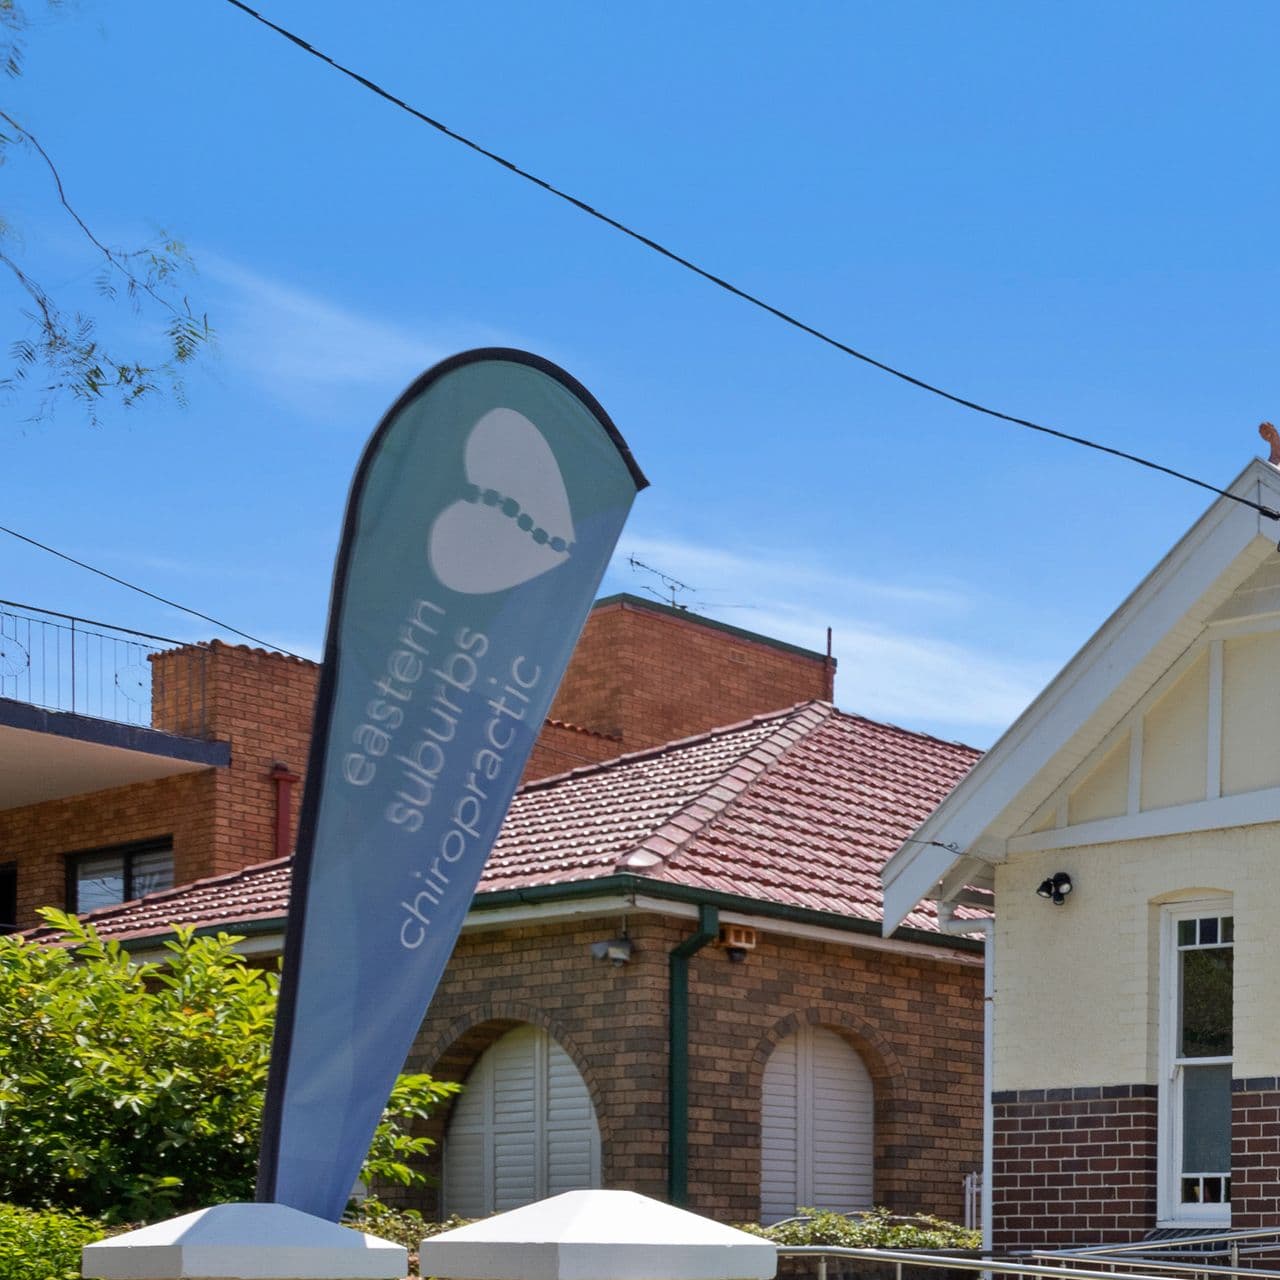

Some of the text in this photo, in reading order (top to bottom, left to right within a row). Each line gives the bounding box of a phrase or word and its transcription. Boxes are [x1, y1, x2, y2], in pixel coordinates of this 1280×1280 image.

[343, 599, 446, 787] eastern
[385, 627, 490, 833] suburbs
[400, 655, 541, 950] chiropractic
